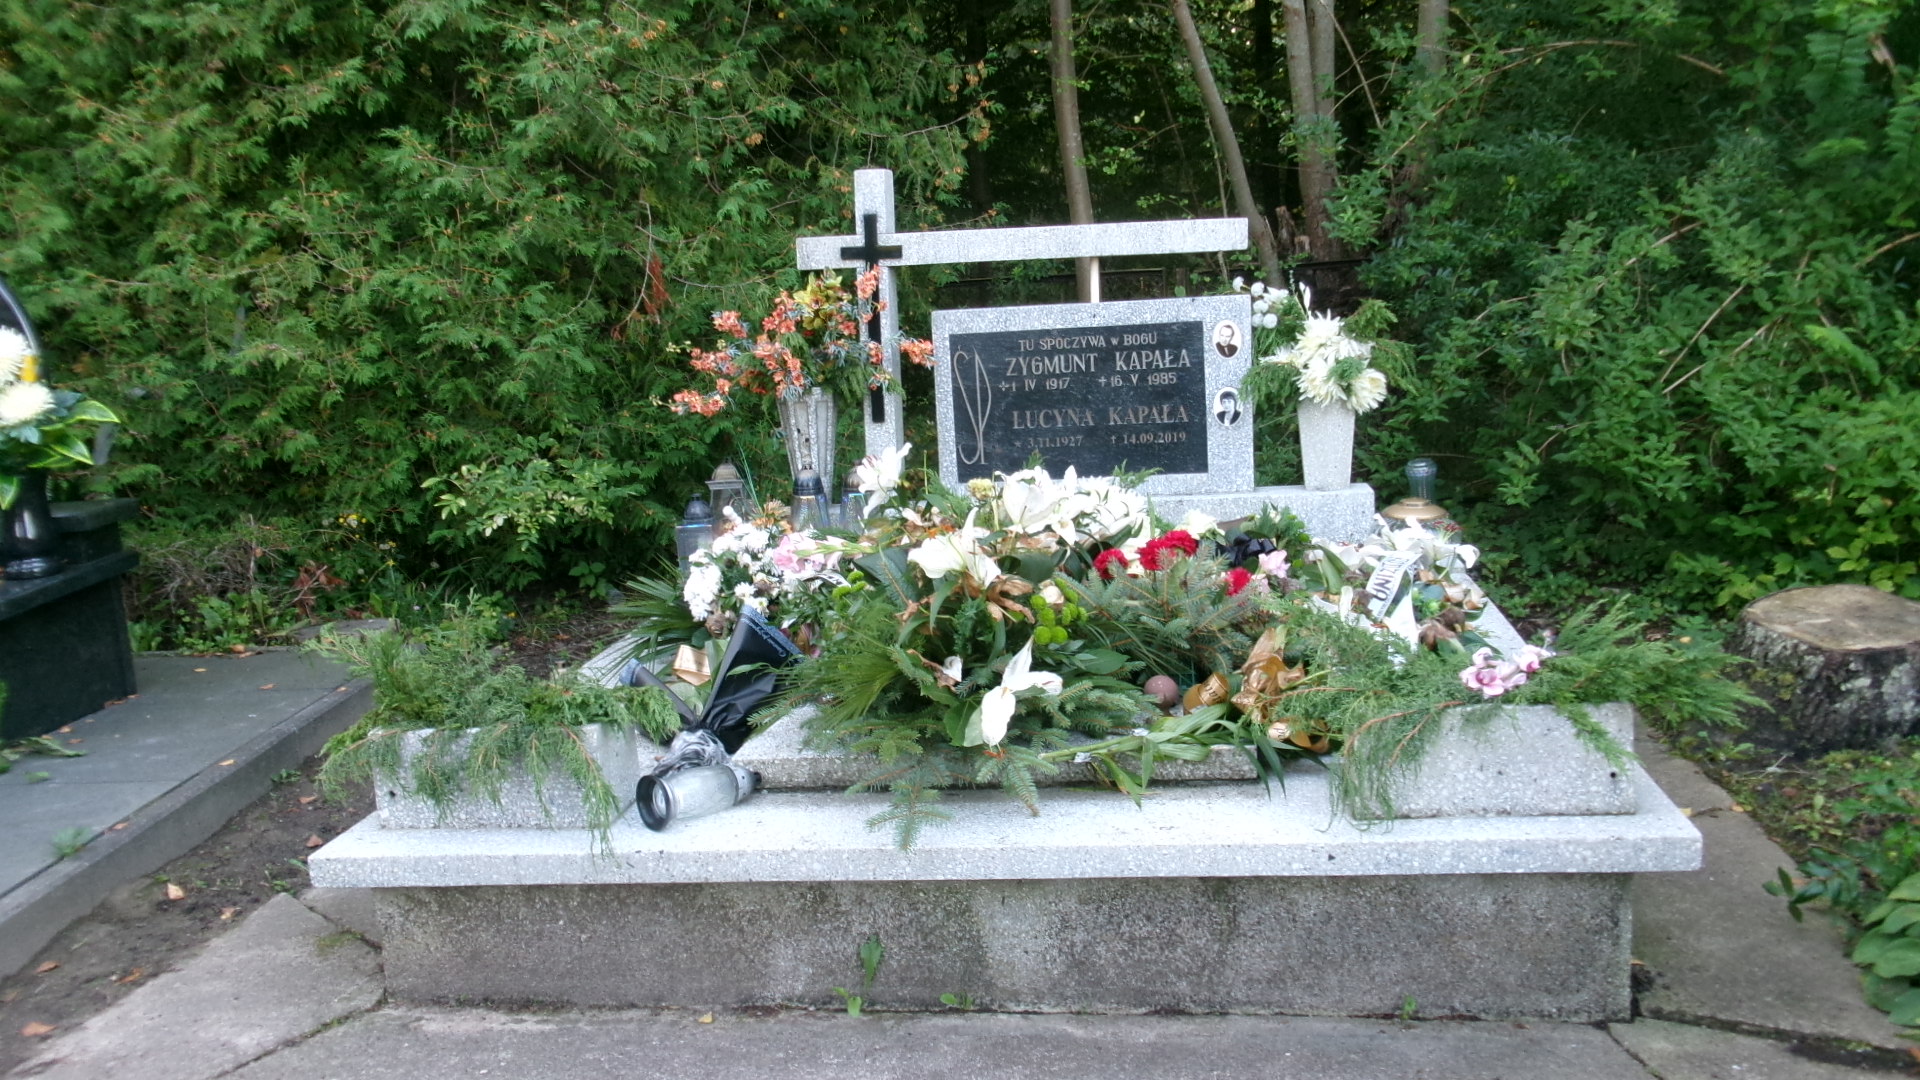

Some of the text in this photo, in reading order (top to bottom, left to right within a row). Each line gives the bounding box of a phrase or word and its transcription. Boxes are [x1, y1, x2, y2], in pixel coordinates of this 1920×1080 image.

[1019, 340, 1034, 351] TU
[1040, 336, 1106, 350] SPOCZYWA
[1123, 332, 1157, 345] BOGU
[1006, 349, 1191, 376] ZYGMUNT KAPAŁA
[1024, 380, 1036, 391] IV
[1046, 377, 1070, 390] 1917
[1130, 374, 1140, 386] V
[1147, 373, 1177, 385] 1985
[1012, 404, 1189, 429] LUCYNA KAPAŁA
[1123, 432, 1186, 444] 14.09.2019
